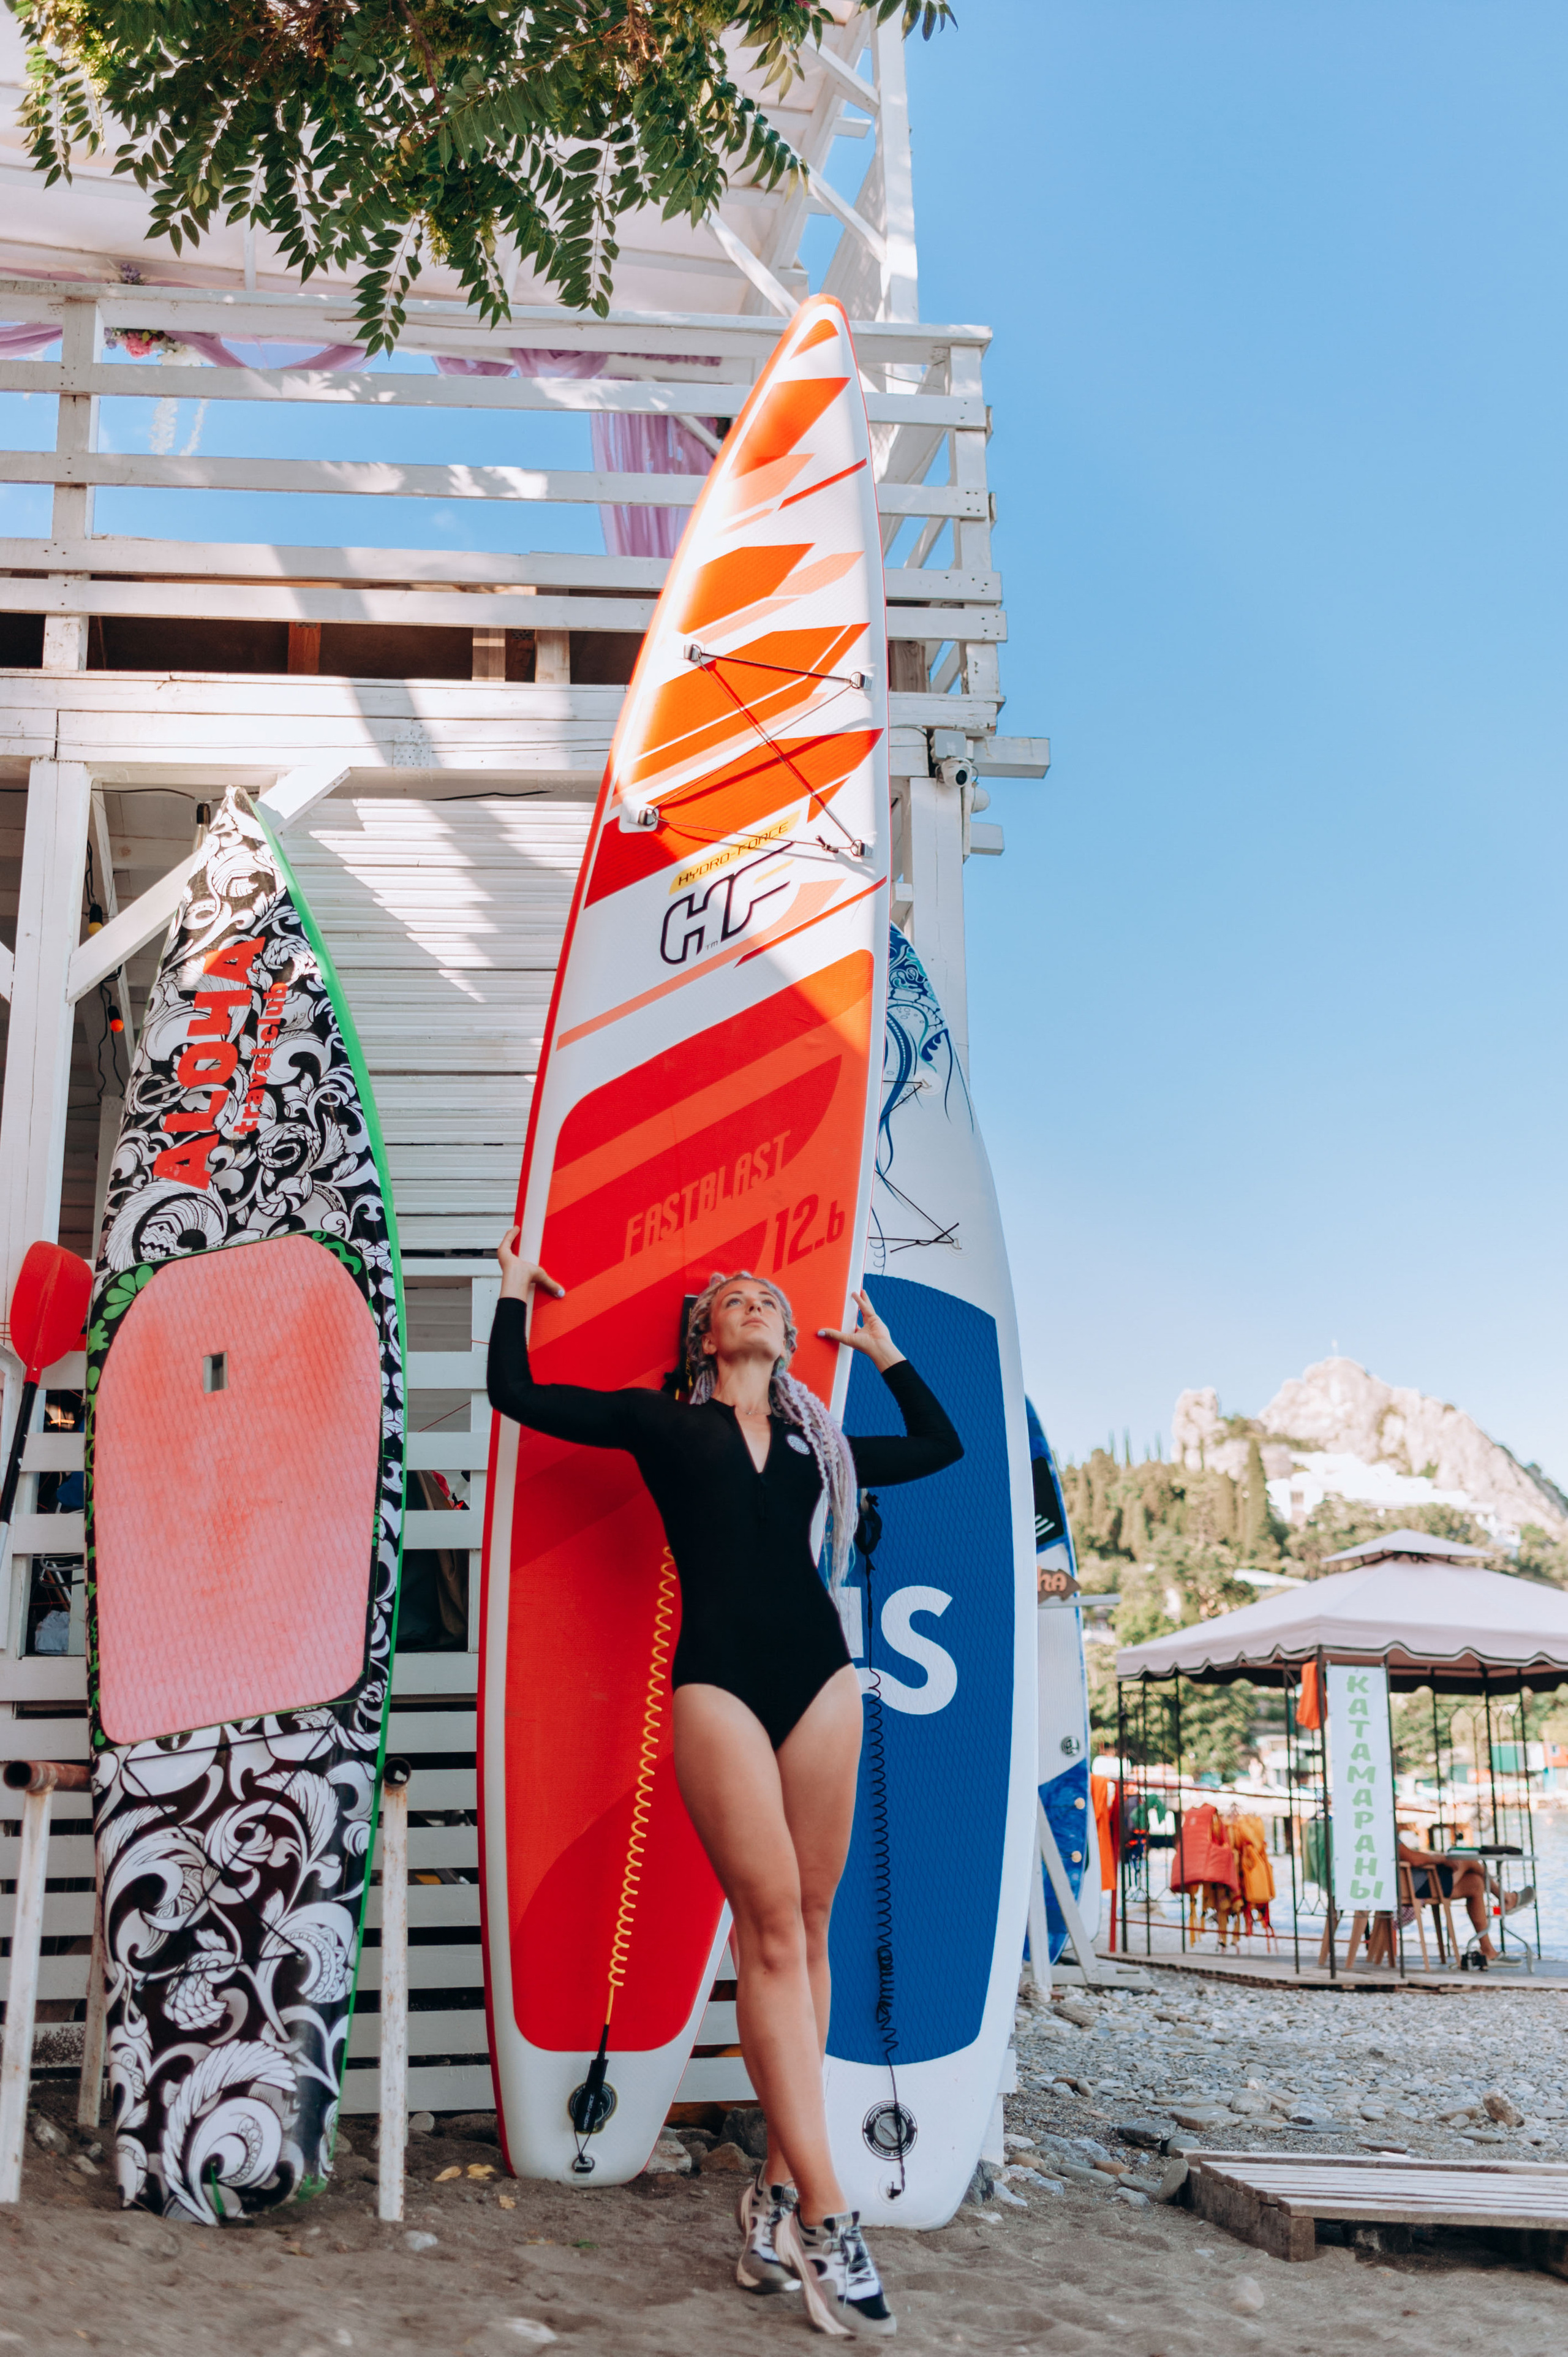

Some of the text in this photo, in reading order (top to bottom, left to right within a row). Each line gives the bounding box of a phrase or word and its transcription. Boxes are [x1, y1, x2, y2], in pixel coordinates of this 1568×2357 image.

[660, 841, 796, 965] HF
[678, 821, 789, 886] HYDRO-FORCE
[153, 936, 266, 1190] ALOHA
[233, 982, 289, 1135] travel club
[624, 1129, 791, 1262] FASTBLAST
[1346, 1674, 1384, 1900] КАТАМАРАНЫ
